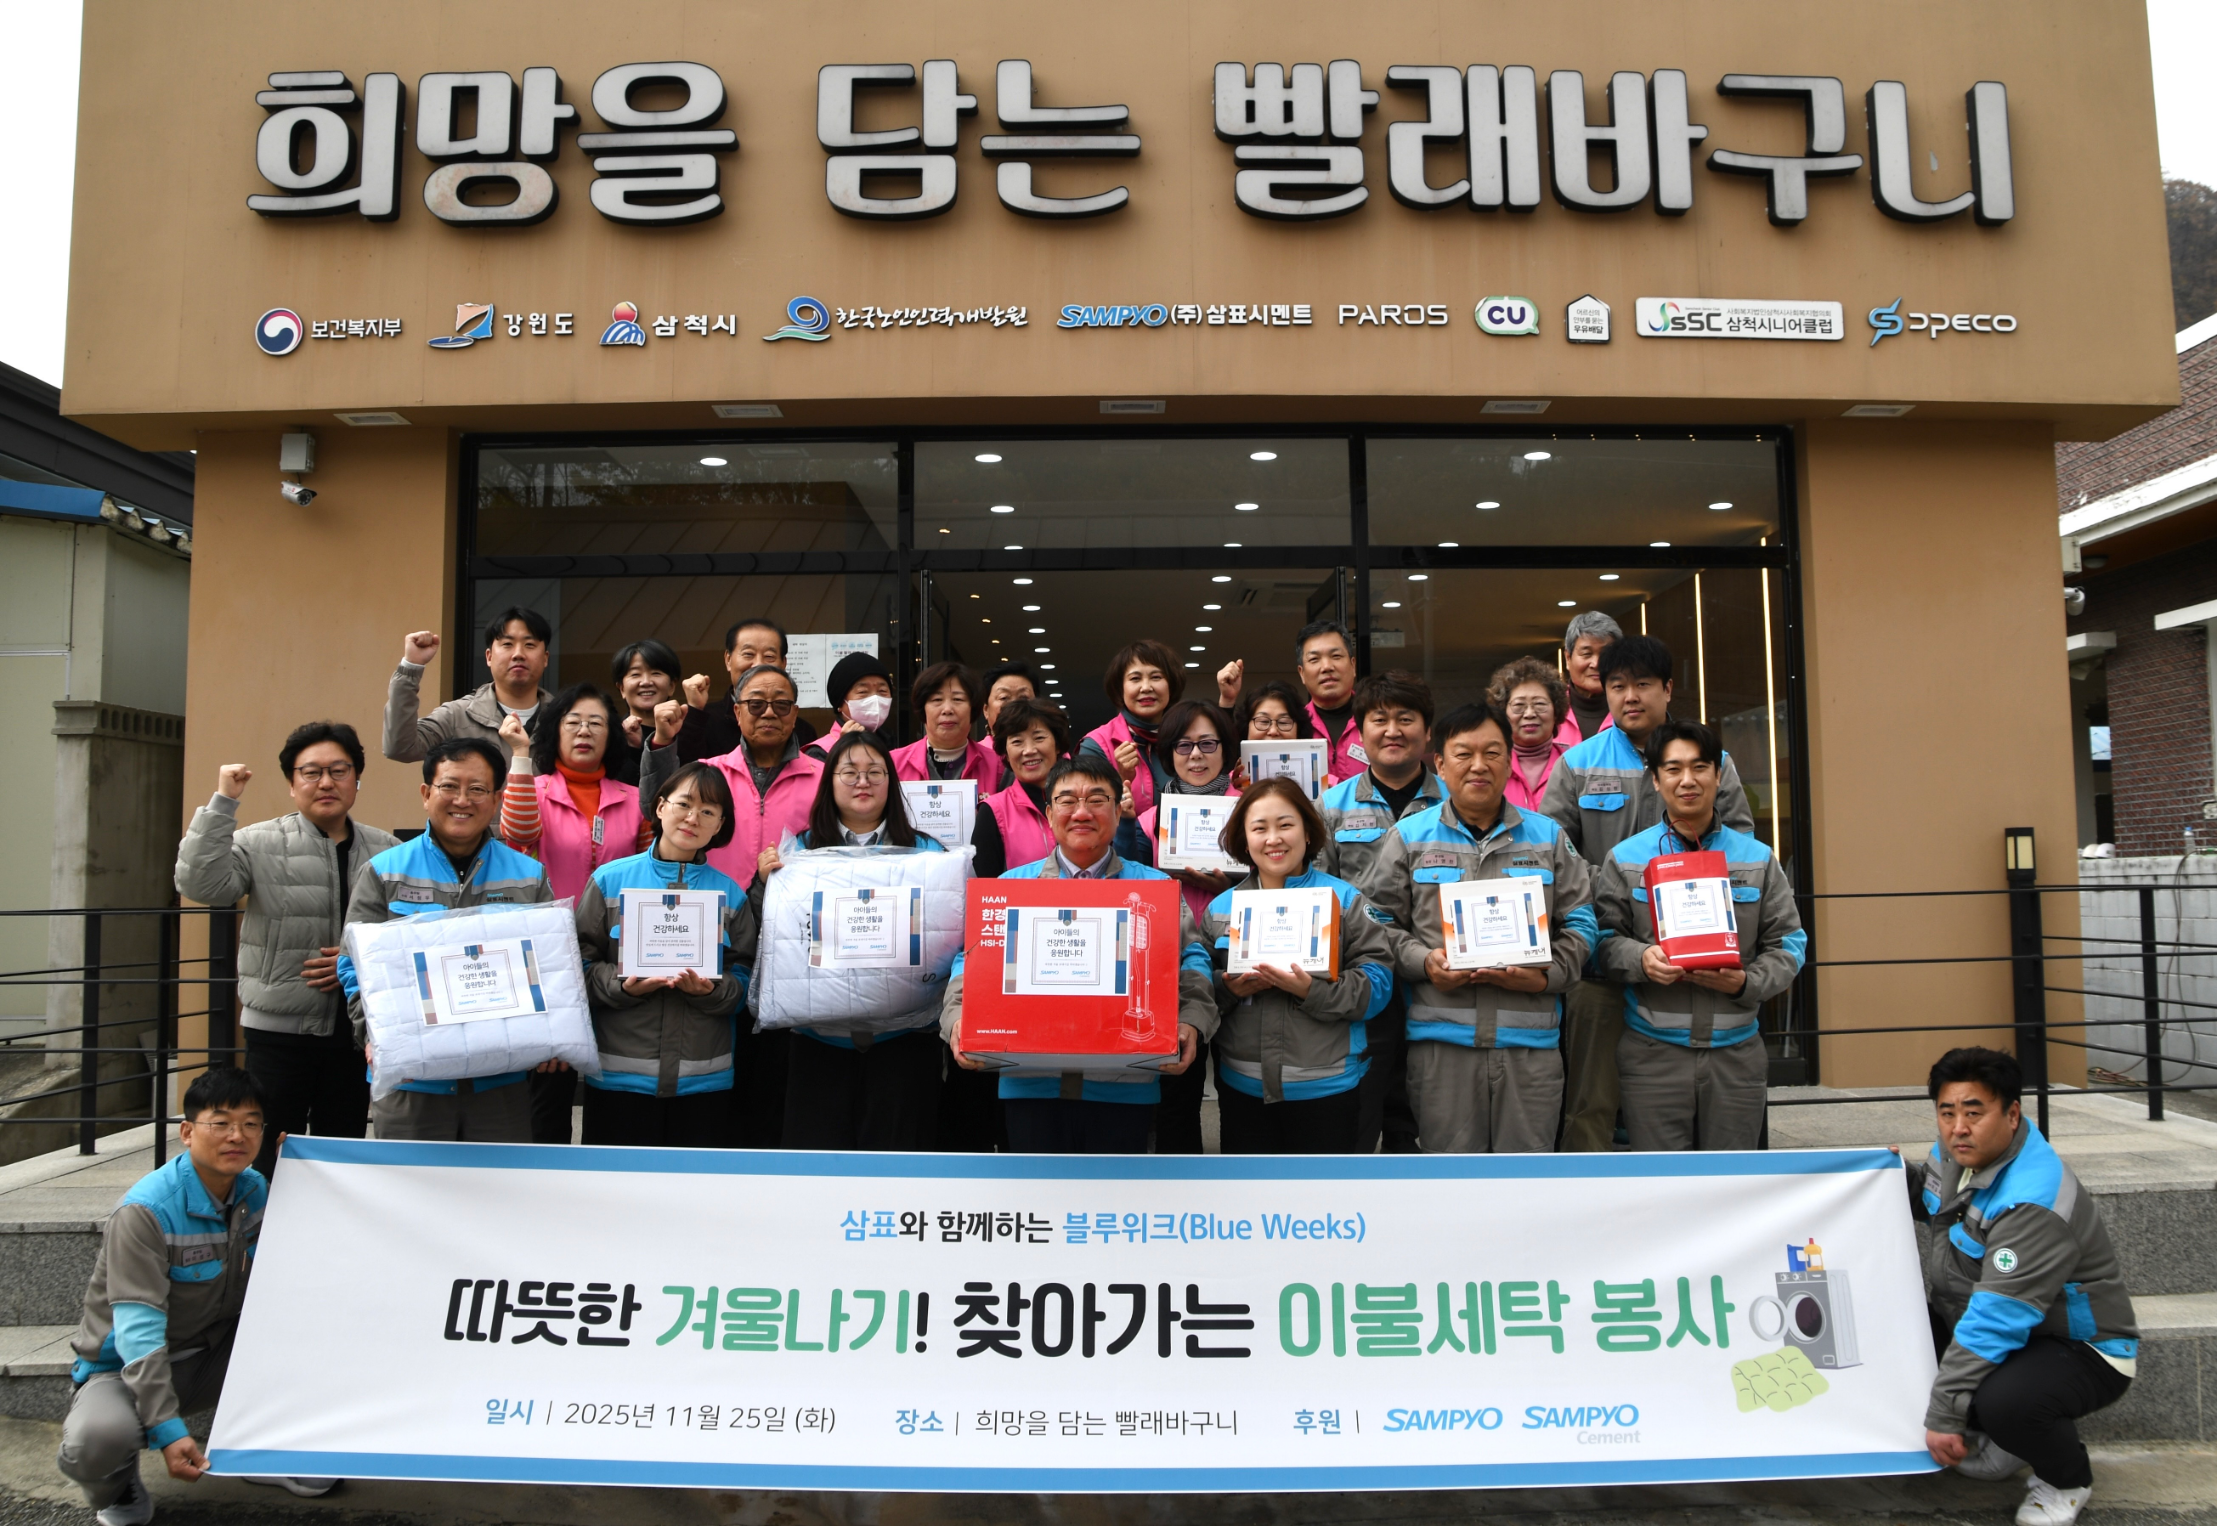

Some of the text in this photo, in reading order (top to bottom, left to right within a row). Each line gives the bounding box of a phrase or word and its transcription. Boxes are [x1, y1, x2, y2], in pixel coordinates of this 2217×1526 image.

[247, 58, 2015, 226] 희망을 담는 빨래바구니
[503, 312, 574, 337] 강원도
[652, 314, 736, 337] 삼척시
[835, 305, 1028, 329] 한국노인인력개발원
[1057, 304, 1167, 328] SAMPYO
[1338, 304, 1449, 326] PAROS
[1487, 305, 1526, 325] CU
[1726, 317, 1833, 334] 삼척시니어클럽
[311, 318, 401, 339] 보건복지부
[1573, 325, 1604, 334] 우유배달
[981, 896, 1007, 904] HAAN
[664, 913, 679, 922] 항상
[653, 924, 689, 934] 건강하세요
[1053, 929, 1080, 937] 아이들의
[1046, 939, 1066, 947] 건강한
[1051, 949, 1083, 957] 응원합니다
[840, 1210, 1367, 1244] 삼표와 함께하는 블루위크(Blue Weeks)
[443, 1274, 1736, 1359] 따뜻한 겨울나기! 찾아가는 이불세탁 봉사
[485, 1398, 837, 1434] 일시 2025년 11월 25일 (화)
[894, 1408, 1238, 1438] 장소 희망을 담는 빨래바구니
[1292, 1404, 1640, 1436] 후원 SAMPYO SAMPYO
[1576, 1429, 1641, 1445] Cement
